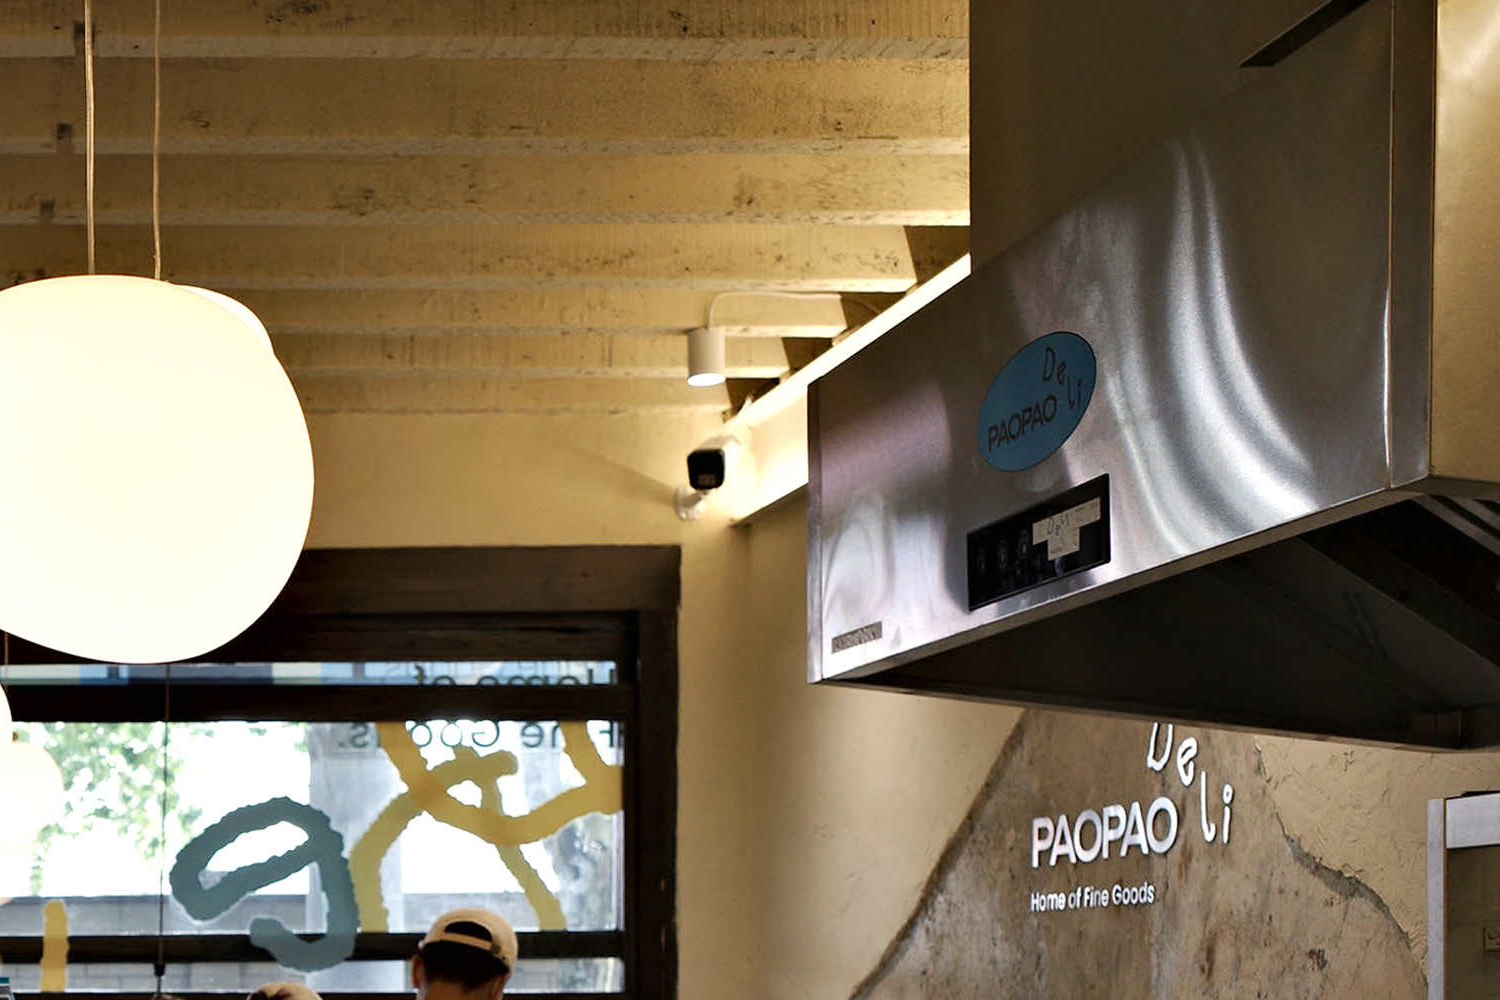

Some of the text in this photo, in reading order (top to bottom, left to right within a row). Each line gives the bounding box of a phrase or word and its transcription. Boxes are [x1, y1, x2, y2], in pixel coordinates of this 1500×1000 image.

[987, 394, 1057, 452] PAOPAO
[1031, 796, 1178, 868] PAOPAO
[1031, 881, 1156, 912] Home of Fine Goods
